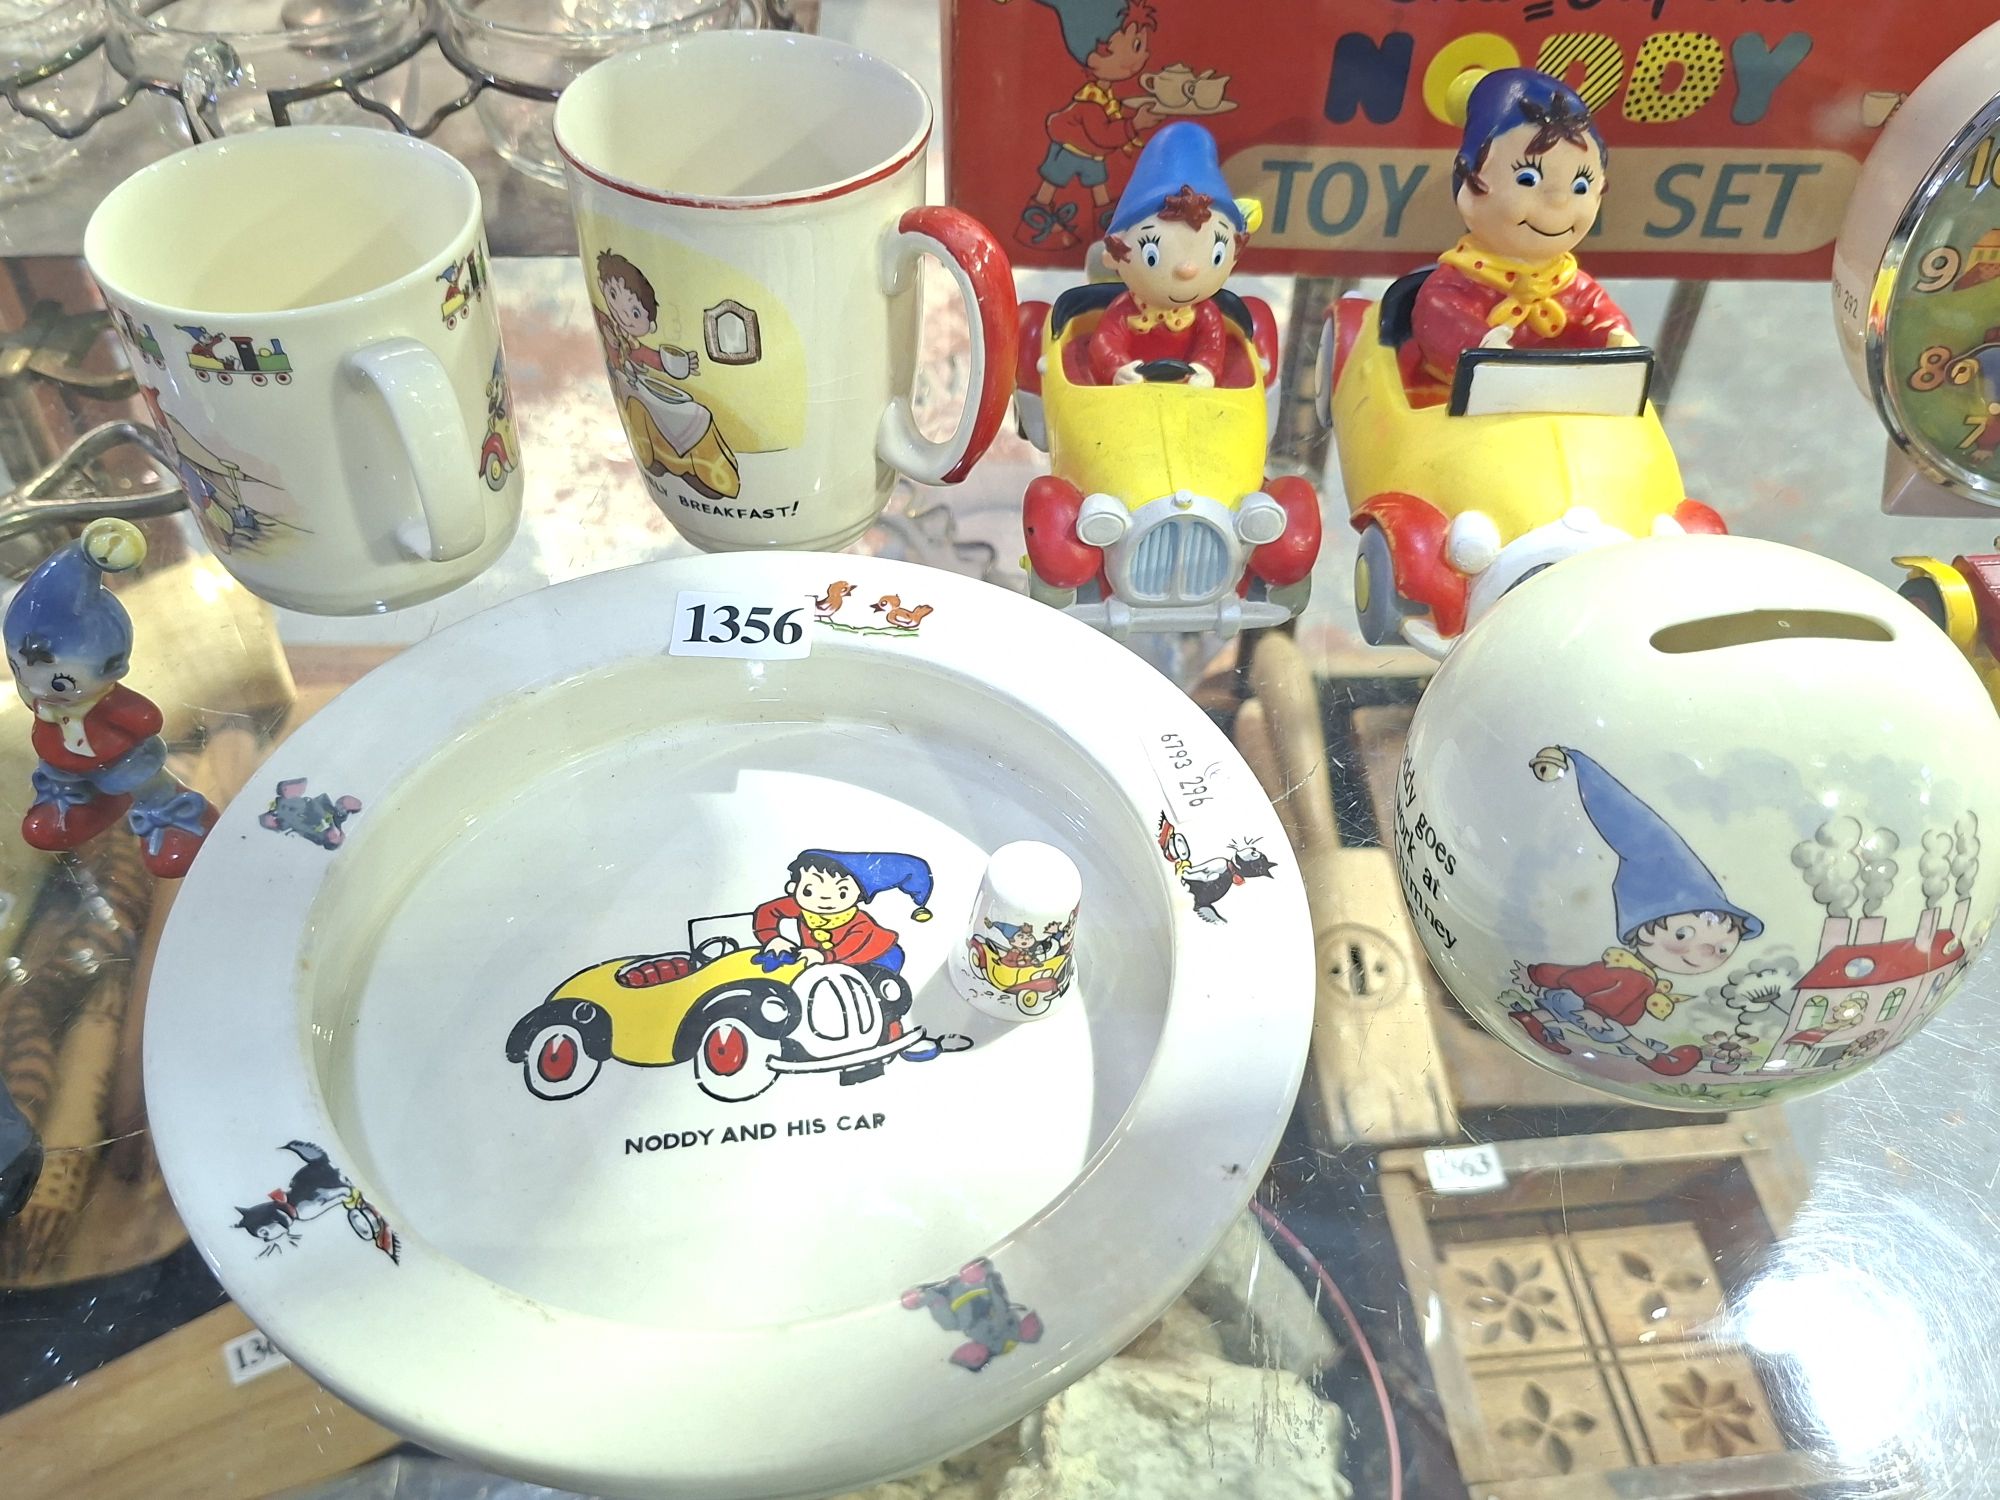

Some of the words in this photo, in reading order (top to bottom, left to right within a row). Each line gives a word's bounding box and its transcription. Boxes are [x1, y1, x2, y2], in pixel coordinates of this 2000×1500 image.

[1324, 32, 1813, 126] NODDY
[1262, 160, 1430, 237] TOY
[1644, 161, 1822, 239] SET
[1911, 246, 1962, 293] 9
[1908, 346, 1952, 392] 8
[1957, 414, 1989, 450] 7
[678, 494, 799, 519] BREAKFAST!
[682, 603, 805, 645] 1356
[1414, 812, 1458, 876] goes
[1422, 866, 1441, 901] at
[625, 1128, 715, 1155] NODDY
[720, 1121, 777, 1144] AND
[787, 1117, 827, 1137] HIS
[836, 1112, 886, 1132] CAR
